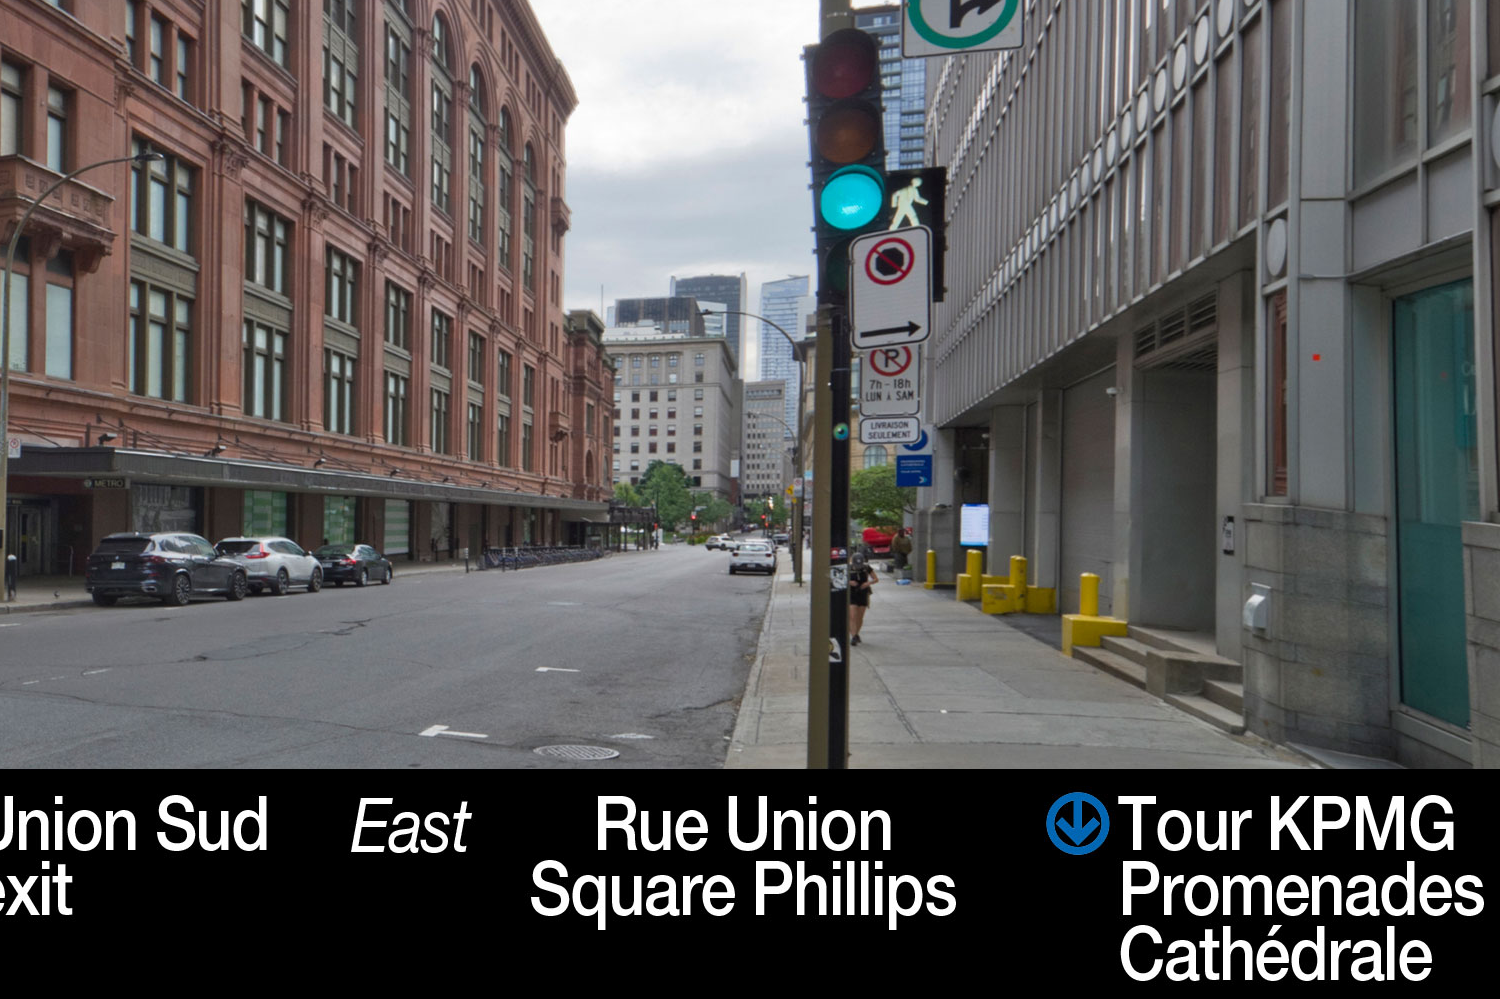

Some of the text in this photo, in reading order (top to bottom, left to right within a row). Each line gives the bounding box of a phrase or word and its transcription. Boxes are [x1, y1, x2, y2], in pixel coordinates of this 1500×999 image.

[869, 379, 882, 390] 7h
[893, 378, 911, 389] 18h
[865, 391, 882, 402] LUN
[896, 390, 914, 401] SAM
[870, 421, 909, 430] LIVRAISON
[867, 430, 911, 440] SEULEMENT
